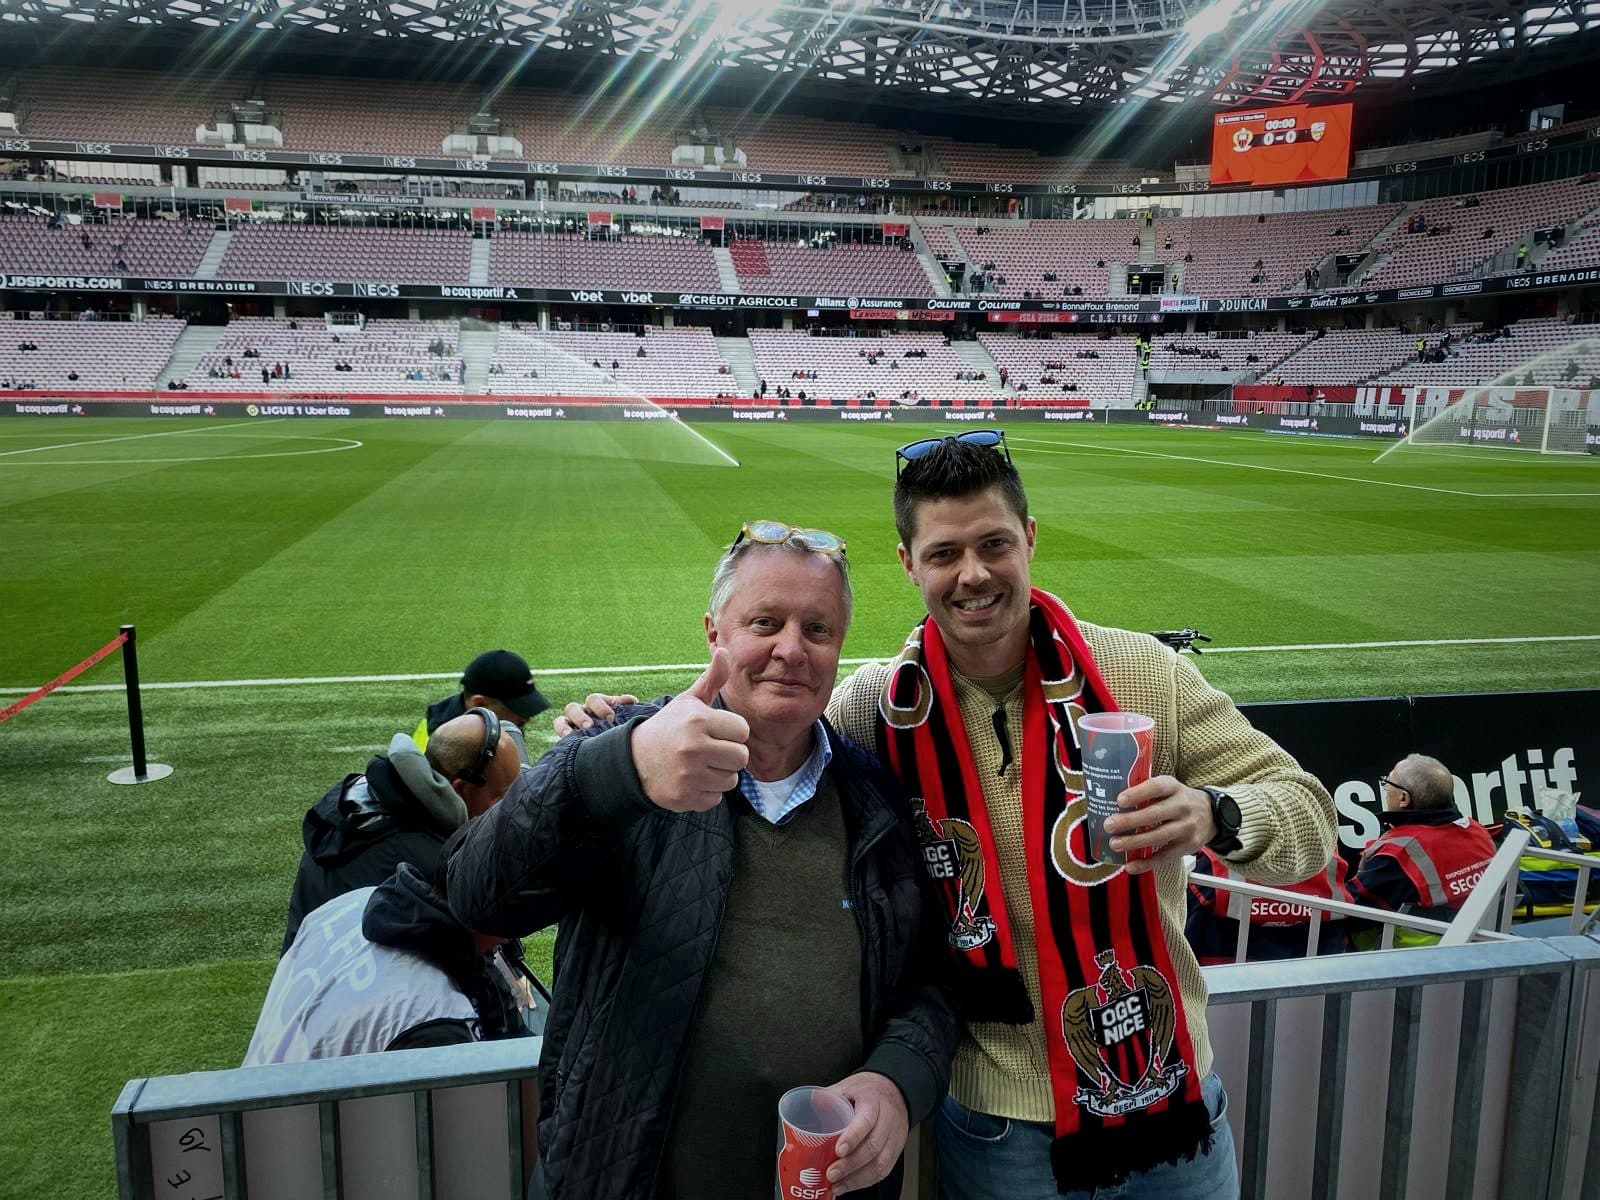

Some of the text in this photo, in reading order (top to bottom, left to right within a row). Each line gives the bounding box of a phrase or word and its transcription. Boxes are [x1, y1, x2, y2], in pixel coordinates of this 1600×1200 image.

[1266, 118, 1296, 130] 00:00
[1264, 132, 1274, 146] 0
[1286, 130, 1296, 144] 0
[0, 141, 30, 150] NEOS
[75, 143, 111, 154] INEOS
[1516, 139, 1548, 154] INEOS
[155, 146, 189, 157] INEOS
[232, 151, 266, 161] INEOS
[310, 153, 342, 164] INEOS
[384, 156, 416, 168] INEOS
[1453, 152, 1485, 166] INEOS
[456, 160, 488, 170] INEOS
[528, 163, 558, 174] INEOS
[1385, 162, 1416, 176] INEOS
[598, 166, 628, 176] INEOS
[666, 169, 695, 180] INEOS
[733, 172, 762, 182] INEOS
[798, 176, 826, 185] INEOS
[862, 178, 890, 188] INEOS
[924, 181, 952, 190] INEOS
[986, 184, 1013, 192] INEOS
[1048, 184, 1076, 193] INEOS
[1113, 184, 1142, 193] INEOS
[1180, 182, 1209, 192] INEOS
[306, 193, 349, 202] Bienvenue
[8, 276, 122, 290] JDSPORTS.COM
[1507, 270, 1600, 288] INEOS GRENADIE
[144, 280, 256, 291] INEOS GRENADIER
[287, 281, 334, 295] INEOS
[352, 283, 400, 296] INEOS
[442, 286, 504, 299] le coq sportif
[571, 290, 603, 302] vbet
[622, 292, 653, 303] vbet
[692, 294, 736, 305] CRÉDIT
[738, 297, 798, 306] AGRICOLE
[815, 298, 902, 308] Allianz Assurance
[1226, 298, 1268, 311] DUNCAN
[1310, 296, 1338, 308] Tourtel
[1062, 302, 1104, 310] Bonnaffoux
[1117, 314, 1138, 323] 1947
[261, 406, 295, 415] LIGUE
[296, 406, 302, 415] 1
[1334, 748, 1578, 848] sortif
[923, 845, 950, 863] GC
[1450, 871, 1484, 895] SECO
[1251, 902, 1312, 917] SECOUR
[1101, 996, 1142, 1026] OGC
[1104, 1016, 1146, 1046] NICE
[790, 1185, 828, 1200] GSF
